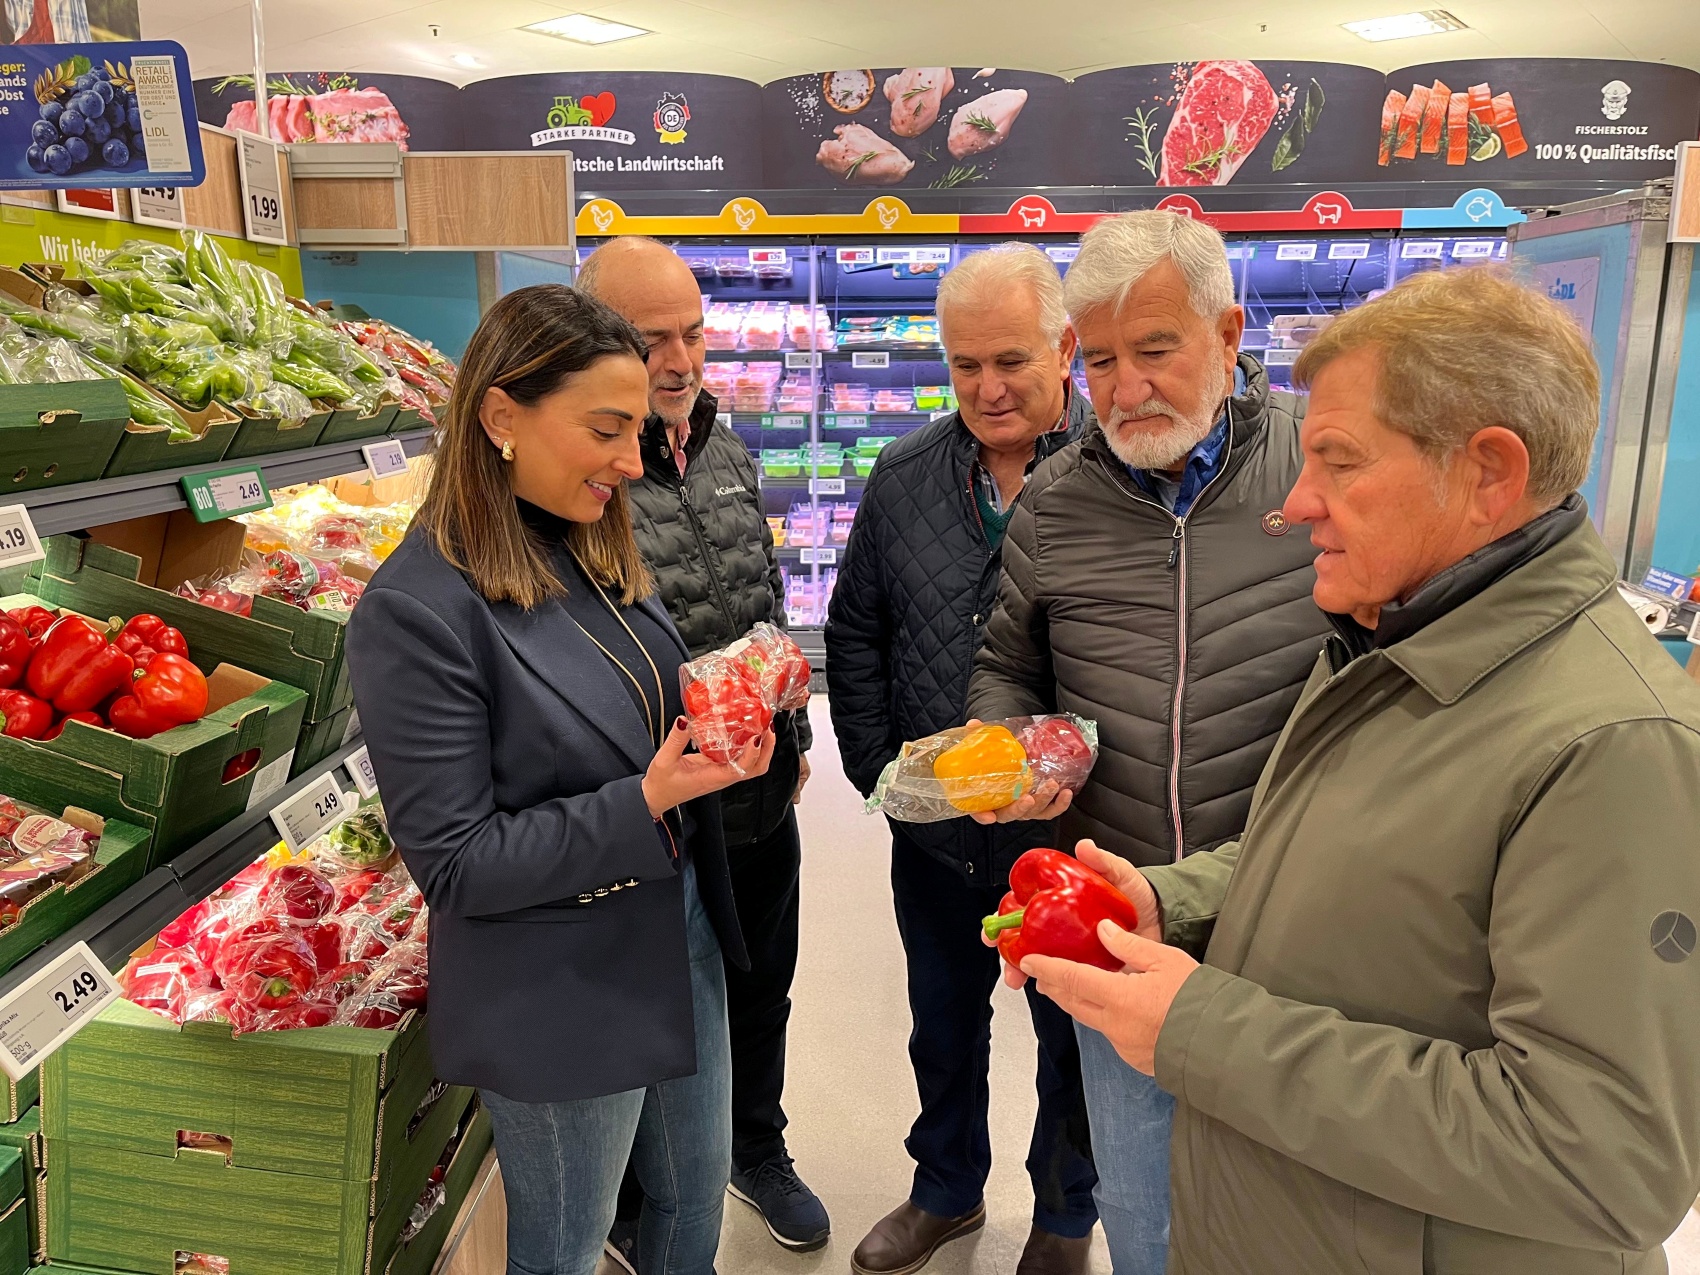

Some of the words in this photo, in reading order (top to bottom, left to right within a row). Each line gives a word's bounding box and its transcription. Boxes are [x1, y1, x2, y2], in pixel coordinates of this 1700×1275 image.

[136, 66, 169, 76] RETAIL
[138, 75, 170, 85] AWARD
[145, 127, 170, 137] LIDL
[537, 129, 576, 142] STARKE
[582, 128, 630, 142] PARTNER
[1575, 125, 1649, 135] FISCHERSTOLZ
[1535, 143, 1563, 160] 100
[1565, 144, 1577, 160] %
[617, 155, 724, 172] Landwirtschaft
[251, 194, 279, 221] 1.99
[40, 235, 69, 262] Wir
[389, 453, 402, 466] 2.19
[239, 482, 261, 500] 2.49
[720, 484, 746, 496] Columbia
[315, 792, 338, 818] 2.49
[54, 971, 98, 1013] 2.49
